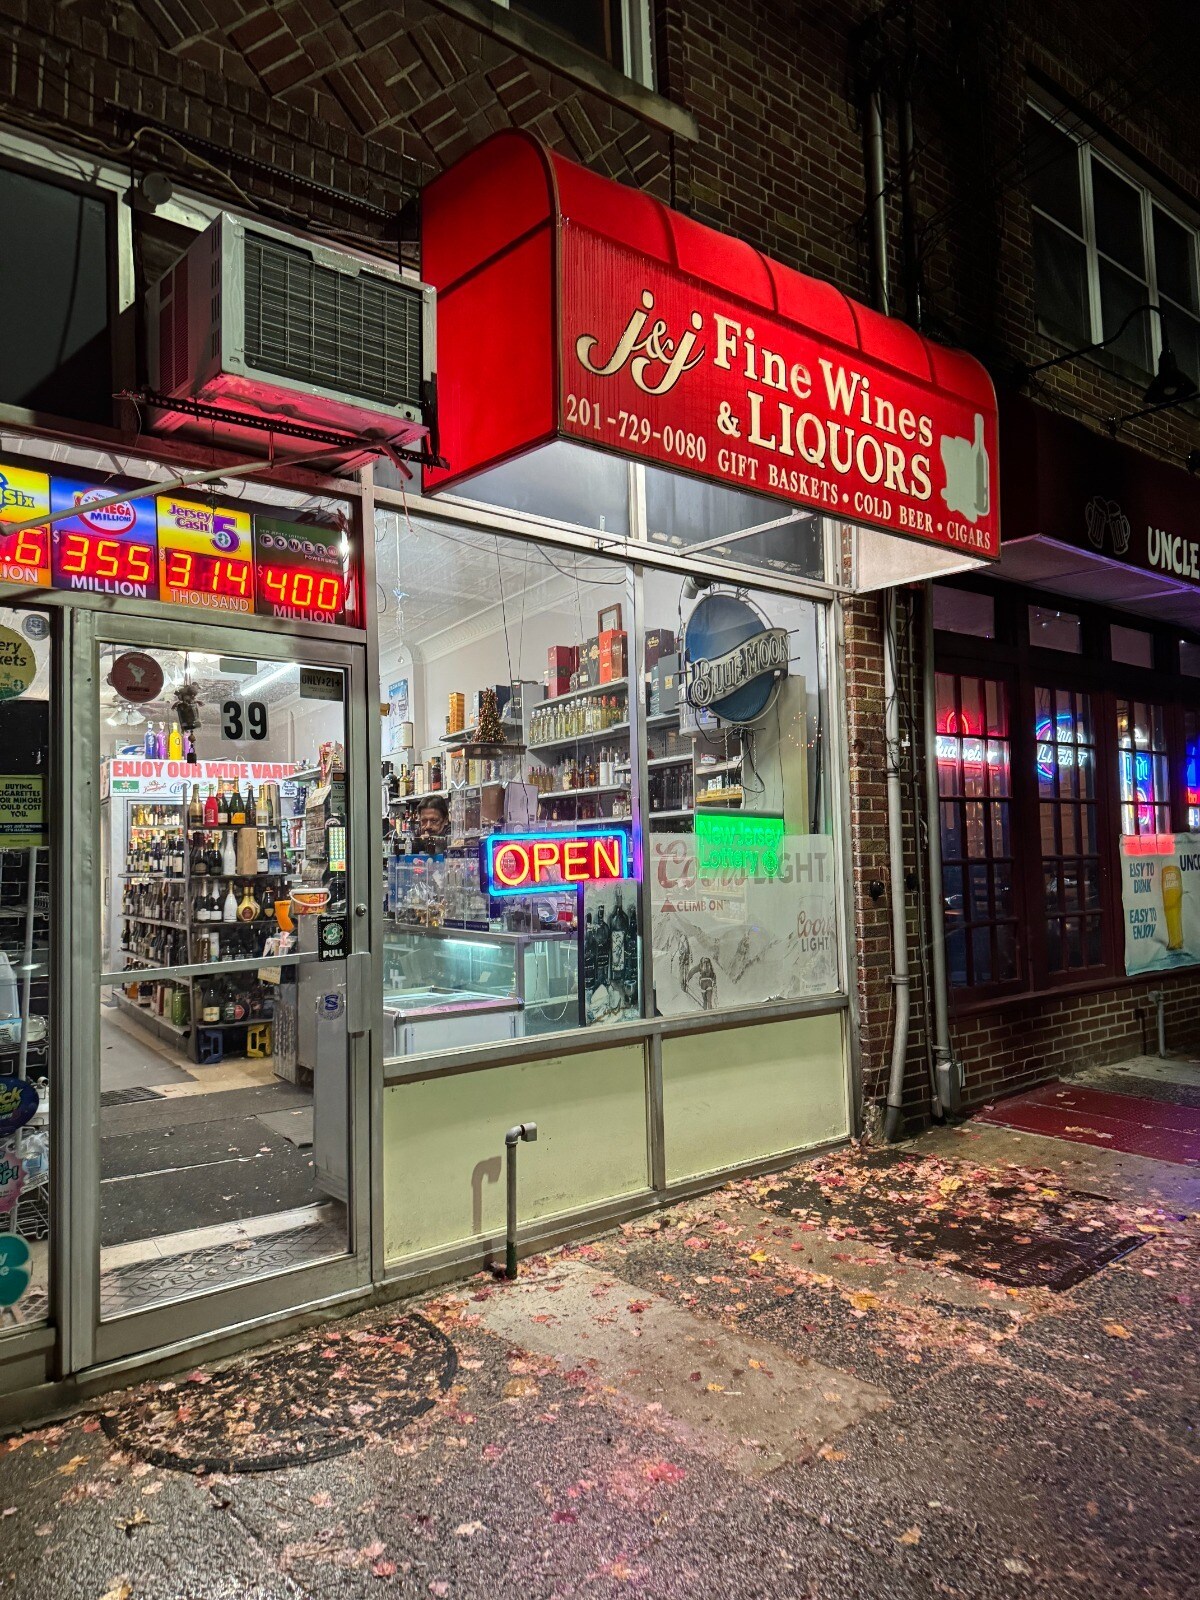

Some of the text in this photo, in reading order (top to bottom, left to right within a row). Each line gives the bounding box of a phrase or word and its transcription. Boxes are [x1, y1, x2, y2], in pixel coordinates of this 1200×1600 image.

[713, 312, 934, 449] Fine Wines
[566, 393, 707, 463] 201-729-0080
[715, 390, 933, 501] & LIQUORS
[168, 503, 212, 524] Jersey
[717, 449, 991, 550] GIFT BASKETS COLD BEER CIGARS
[90, 511, 132, 523] MILLIONS
[175, 514, 241, 553] Cash 5
[62, 534, 151, 582] 355
[1147, 525, 1200, 580] UNCLE
[70, 573, 148, 599] MILLION
[168, 551, 248, 596] 314
[170, 587, 250, 612] THOUSAND
[266, 569, 339, 610] 400
[272, 603, 337, 625] MILLION
[222, 700, 268, 741] 39
[112, 760, 165, 778] ENJOY
[167, 761, 203, 778] OUR
[205, 763, 250, 779] WIDE
[495, 840, 620, 886] OPEN
[701, 845, 759, 874] Lottery
[677, 899, 725, 913] CLIMB ON
[1129, 908, 1148, 925] EASY
[801, 936, 830, 953] LIGHT
[1132, 924, 1157, 940] ENJOY
[322, 948, 345, 959] PULL
